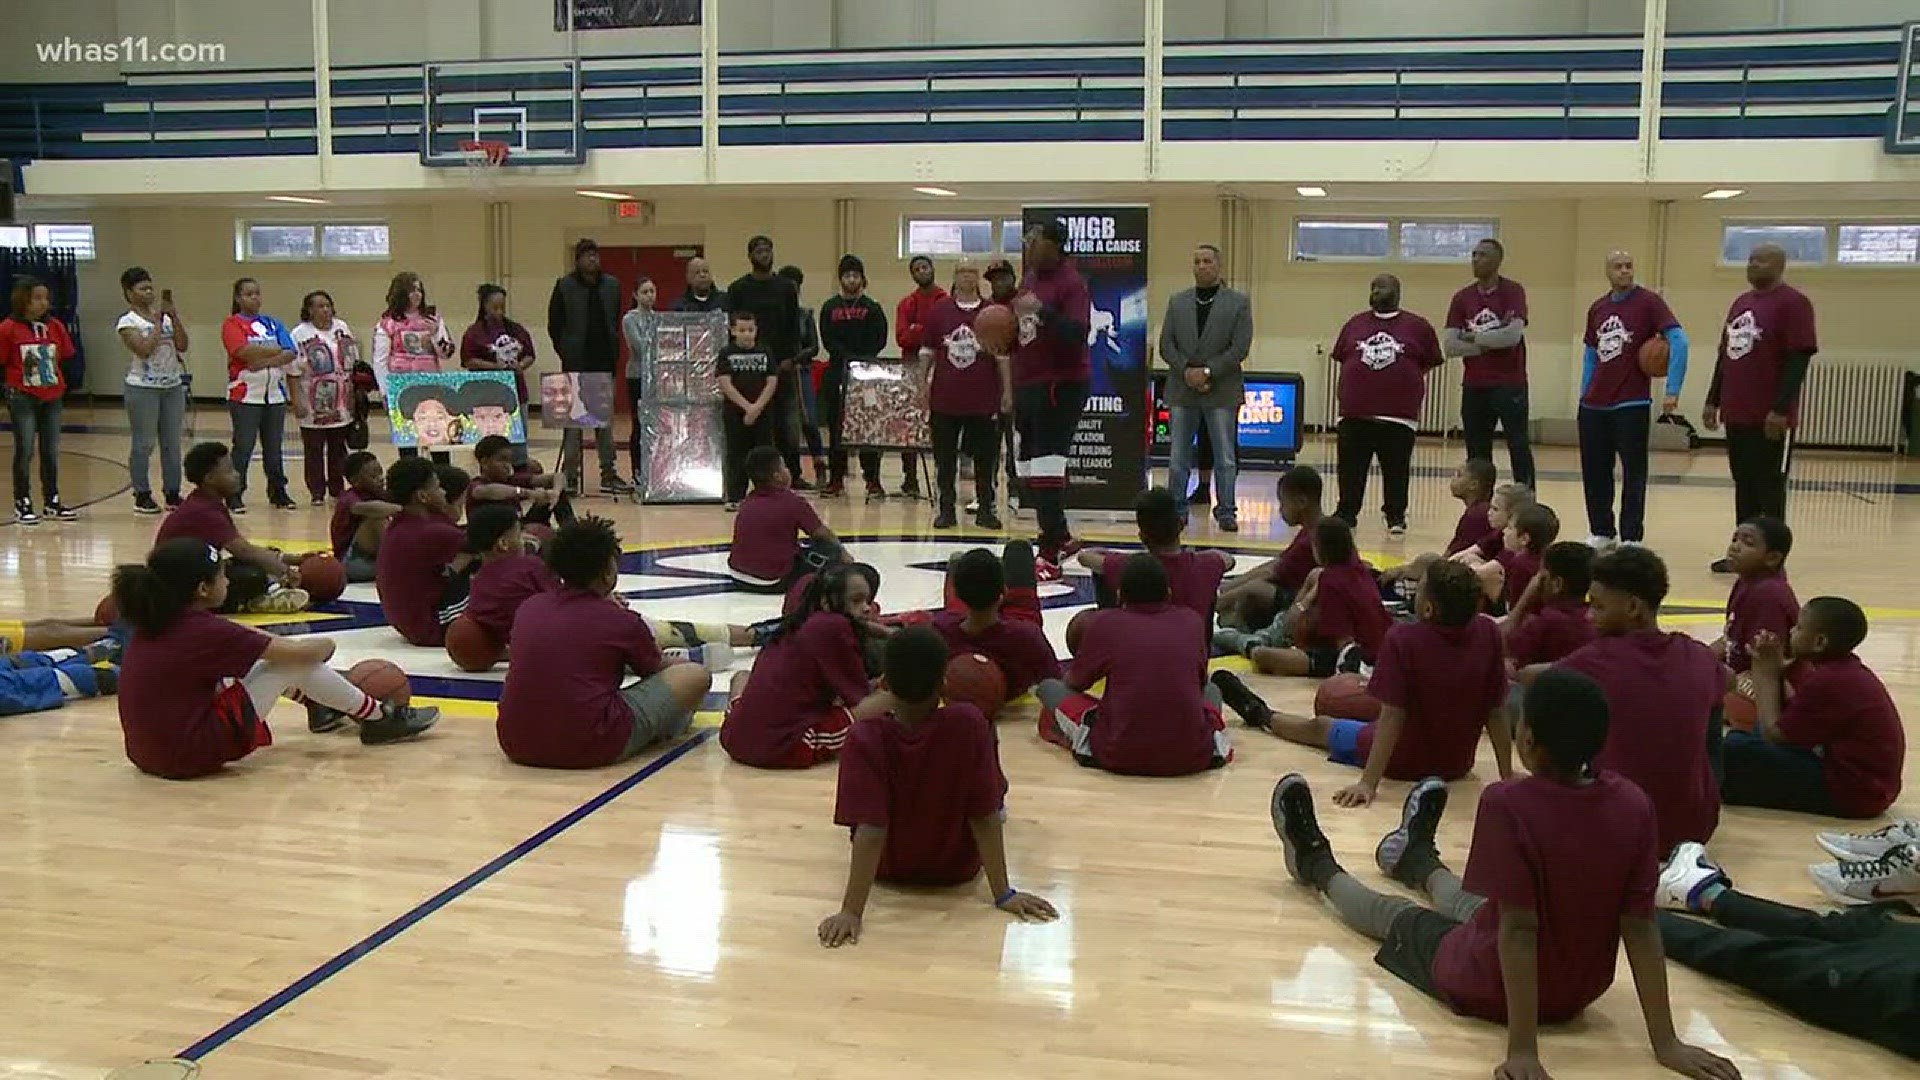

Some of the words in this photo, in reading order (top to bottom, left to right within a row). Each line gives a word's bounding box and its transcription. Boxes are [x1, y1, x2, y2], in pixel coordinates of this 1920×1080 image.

[1073, 240, 1094, 252] FOR
[1096, 240, 1104, 252] A
[1106, 240, 1141, 252] CAUSE
